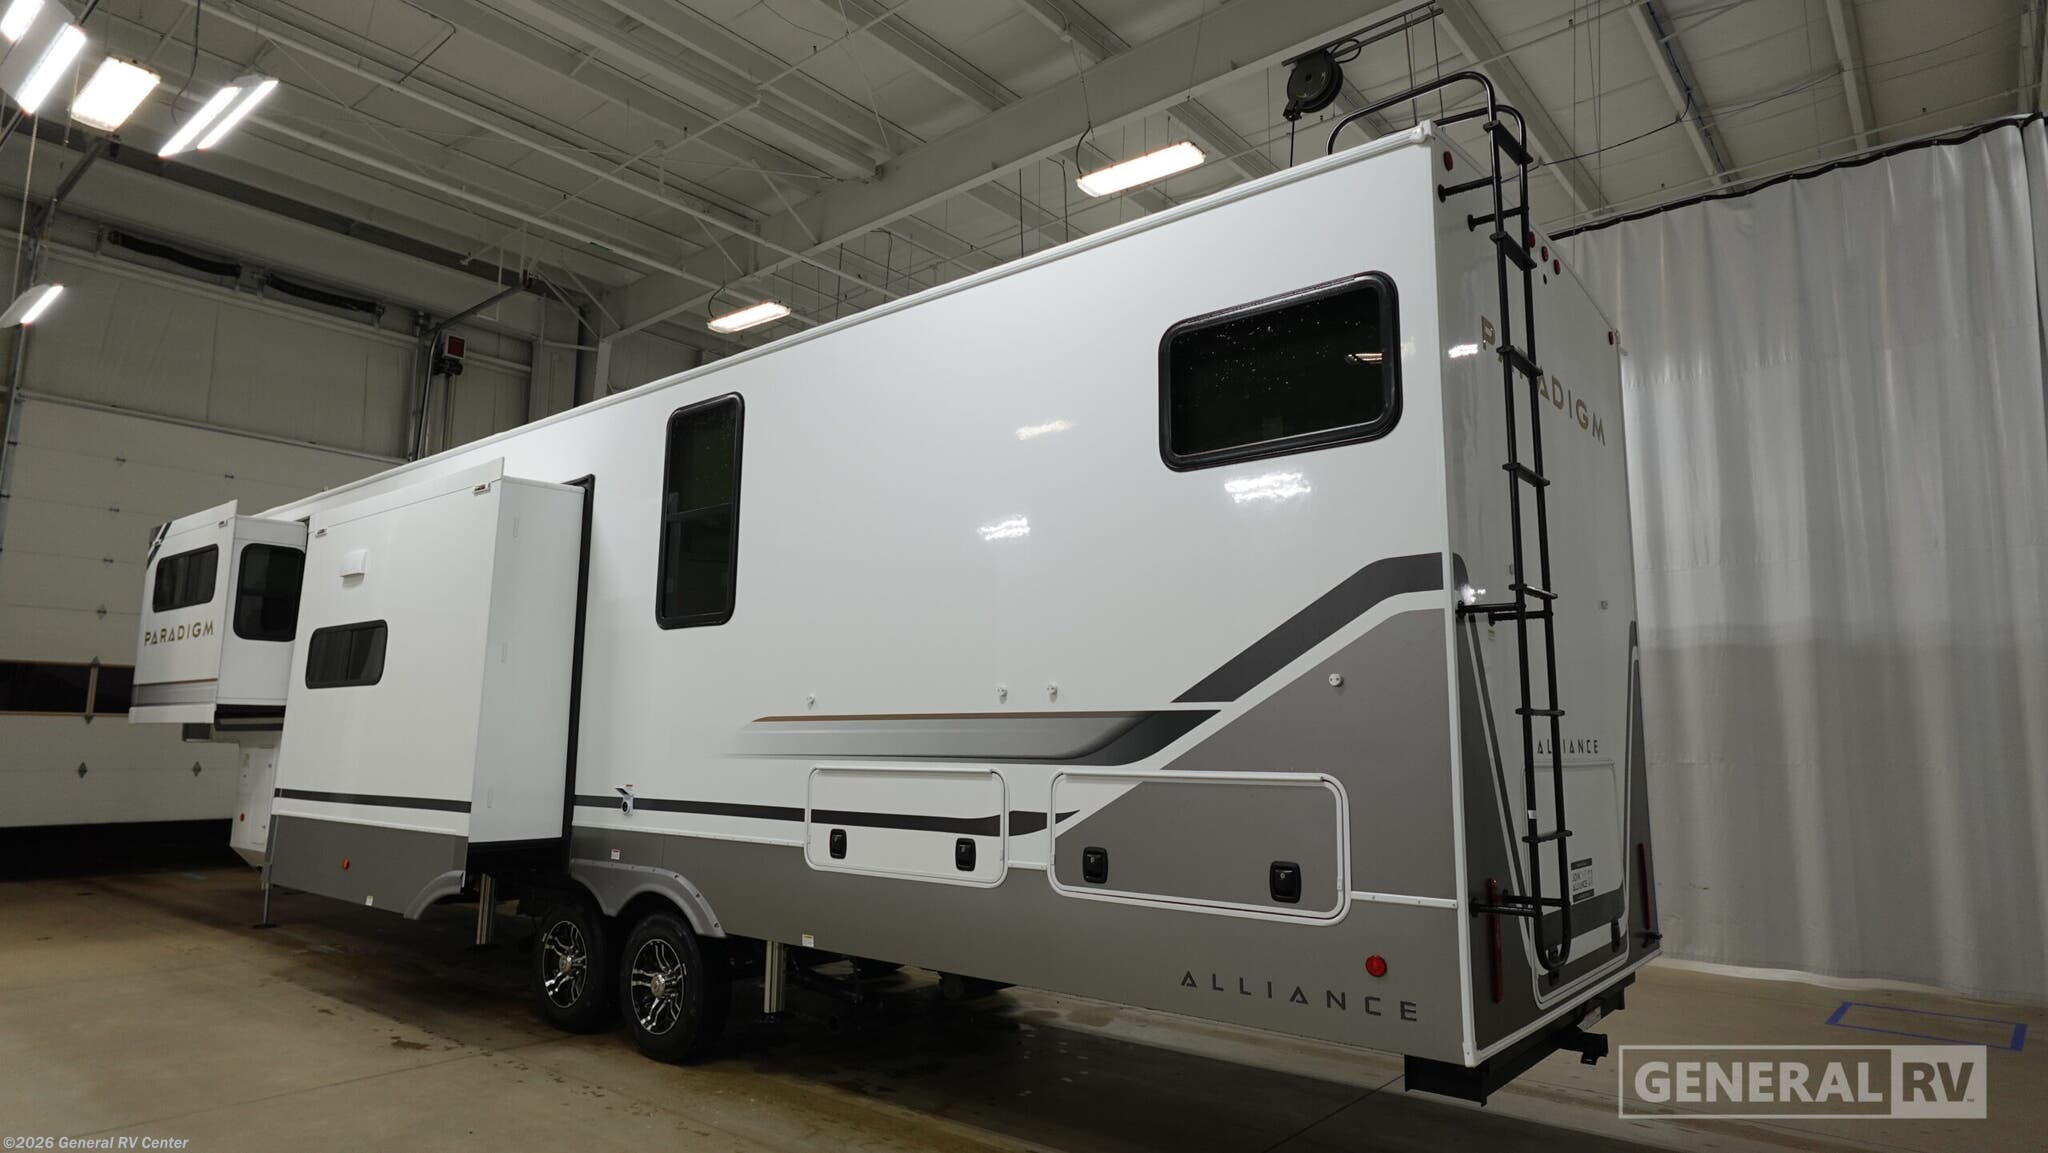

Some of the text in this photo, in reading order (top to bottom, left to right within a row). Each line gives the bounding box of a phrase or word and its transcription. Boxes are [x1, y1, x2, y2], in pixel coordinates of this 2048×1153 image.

[1481, 315, 1606, 446] PADIGM
[144, 620, 214, 647] PARADIGM
[1537, 738, 1599, 754] ALIANCE
[1180, 970, 1418, 1021] ALLIANCE
